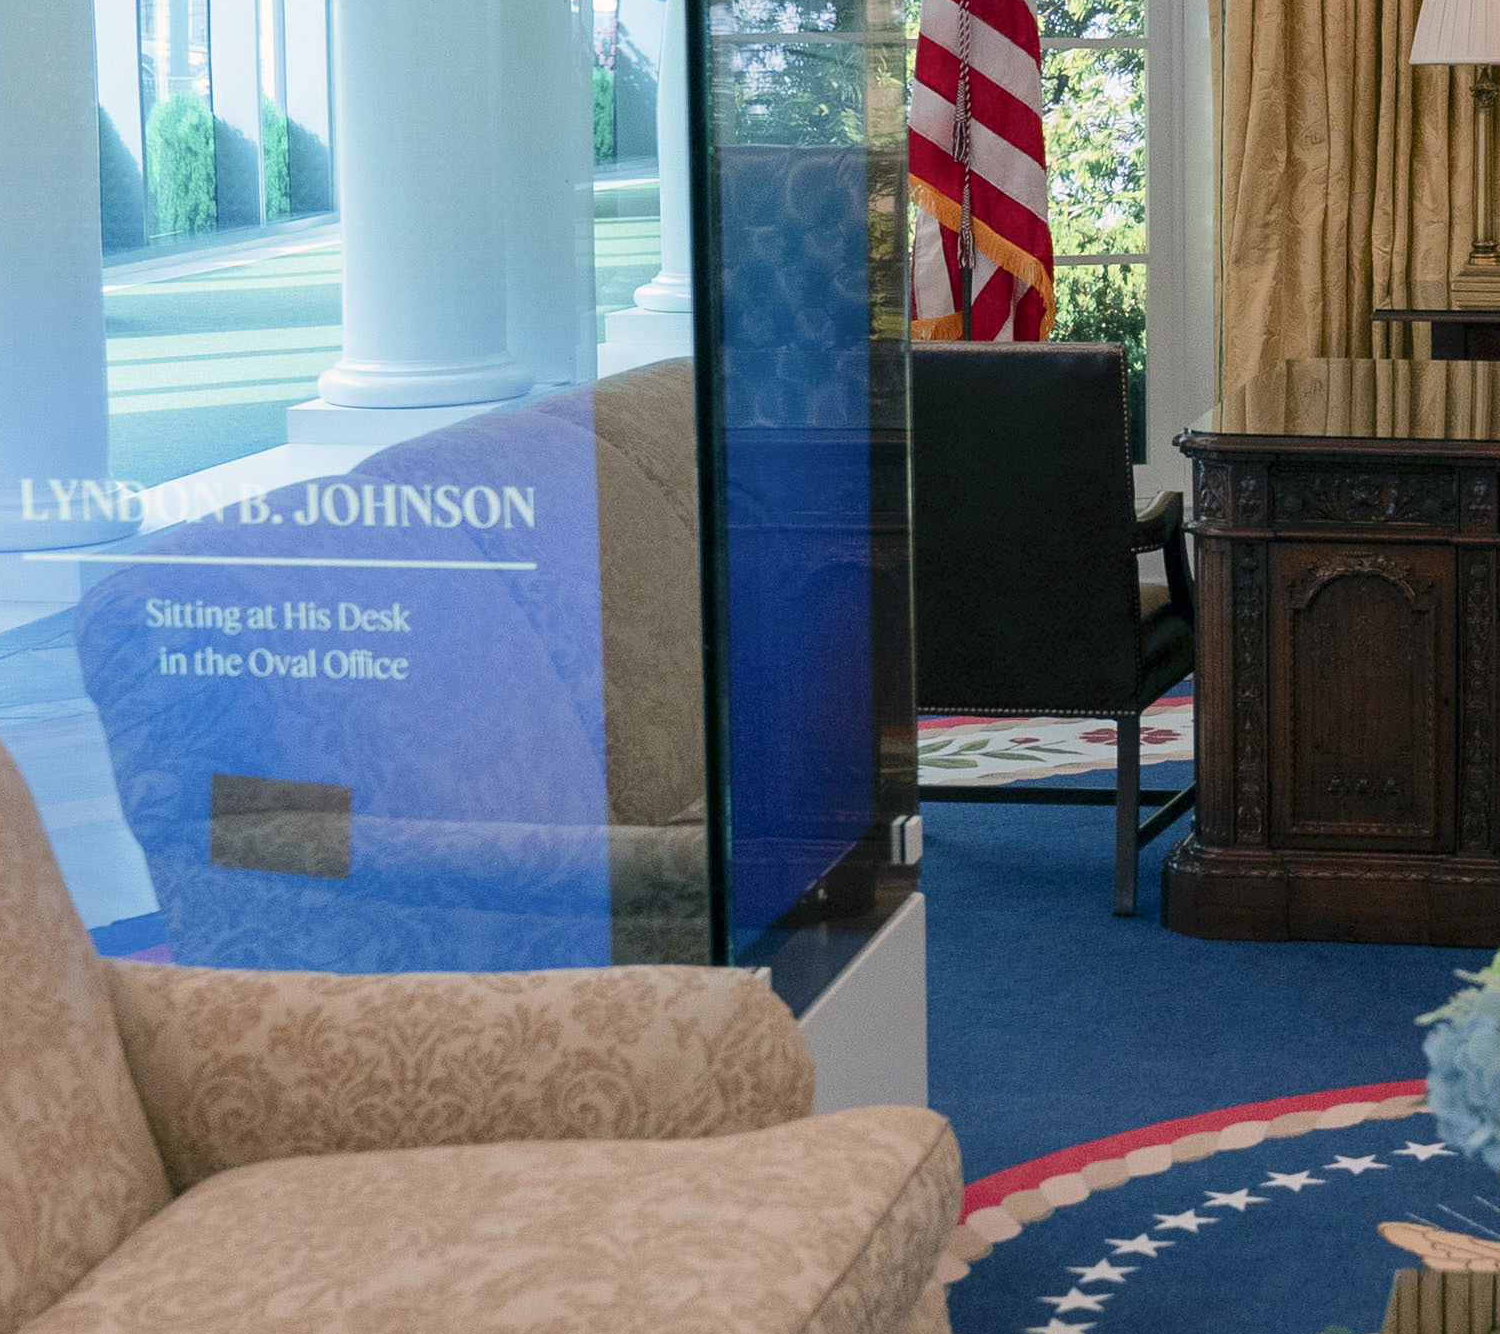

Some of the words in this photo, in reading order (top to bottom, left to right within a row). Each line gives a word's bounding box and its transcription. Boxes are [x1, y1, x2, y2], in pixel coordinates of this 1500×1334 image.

[19, 478, 228, 526] LYNDON
[239, 487, 283, 526] B.
[294, 483, 536, 529] JOHNSON
[146, 598, 242, 635] Sitting
[247, 602, 276, 630] at
[283, 601, 331, 631] His
[338, 602, 411, 632] Desk
[159, 646, 188, 675] in
[194, 646, 243, 676] the
[248, 647, 317, 679] Oval
[323, 649, 409, 680] Office
